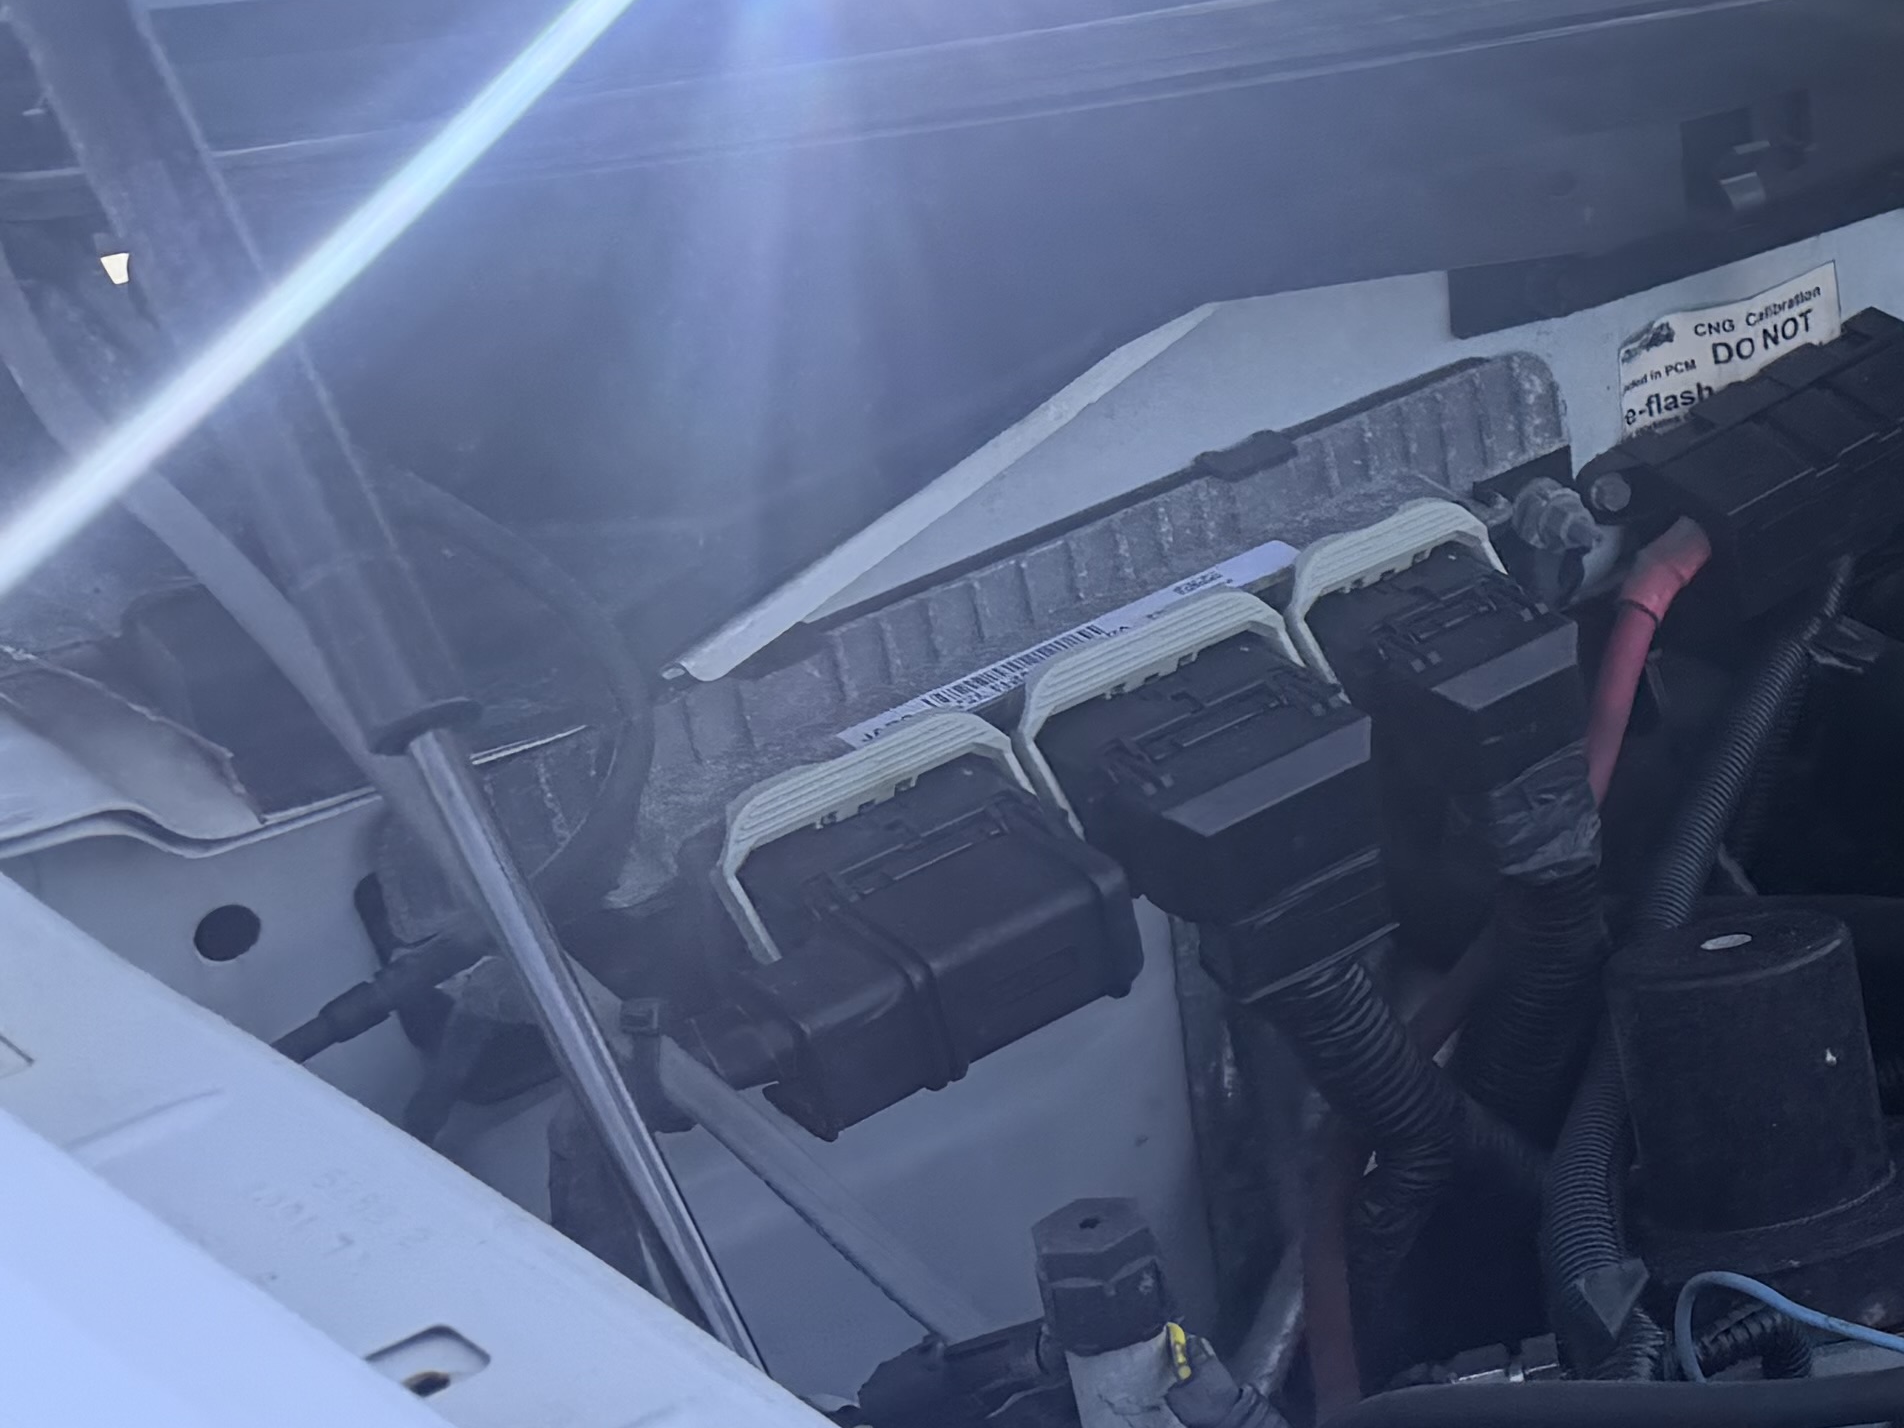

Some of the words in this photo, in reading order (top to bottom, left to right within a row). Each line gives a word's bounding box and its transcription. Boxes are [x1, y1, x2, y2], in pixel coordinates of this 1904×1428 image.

[1693, 318, 1735, 337] CNG
[1712, 336, 1754, 365] DO
[1761, 307, 1812, 350] NOT
[1648, 367, 1662, 381] in
[1663, 356, 1697, 377] PCM
